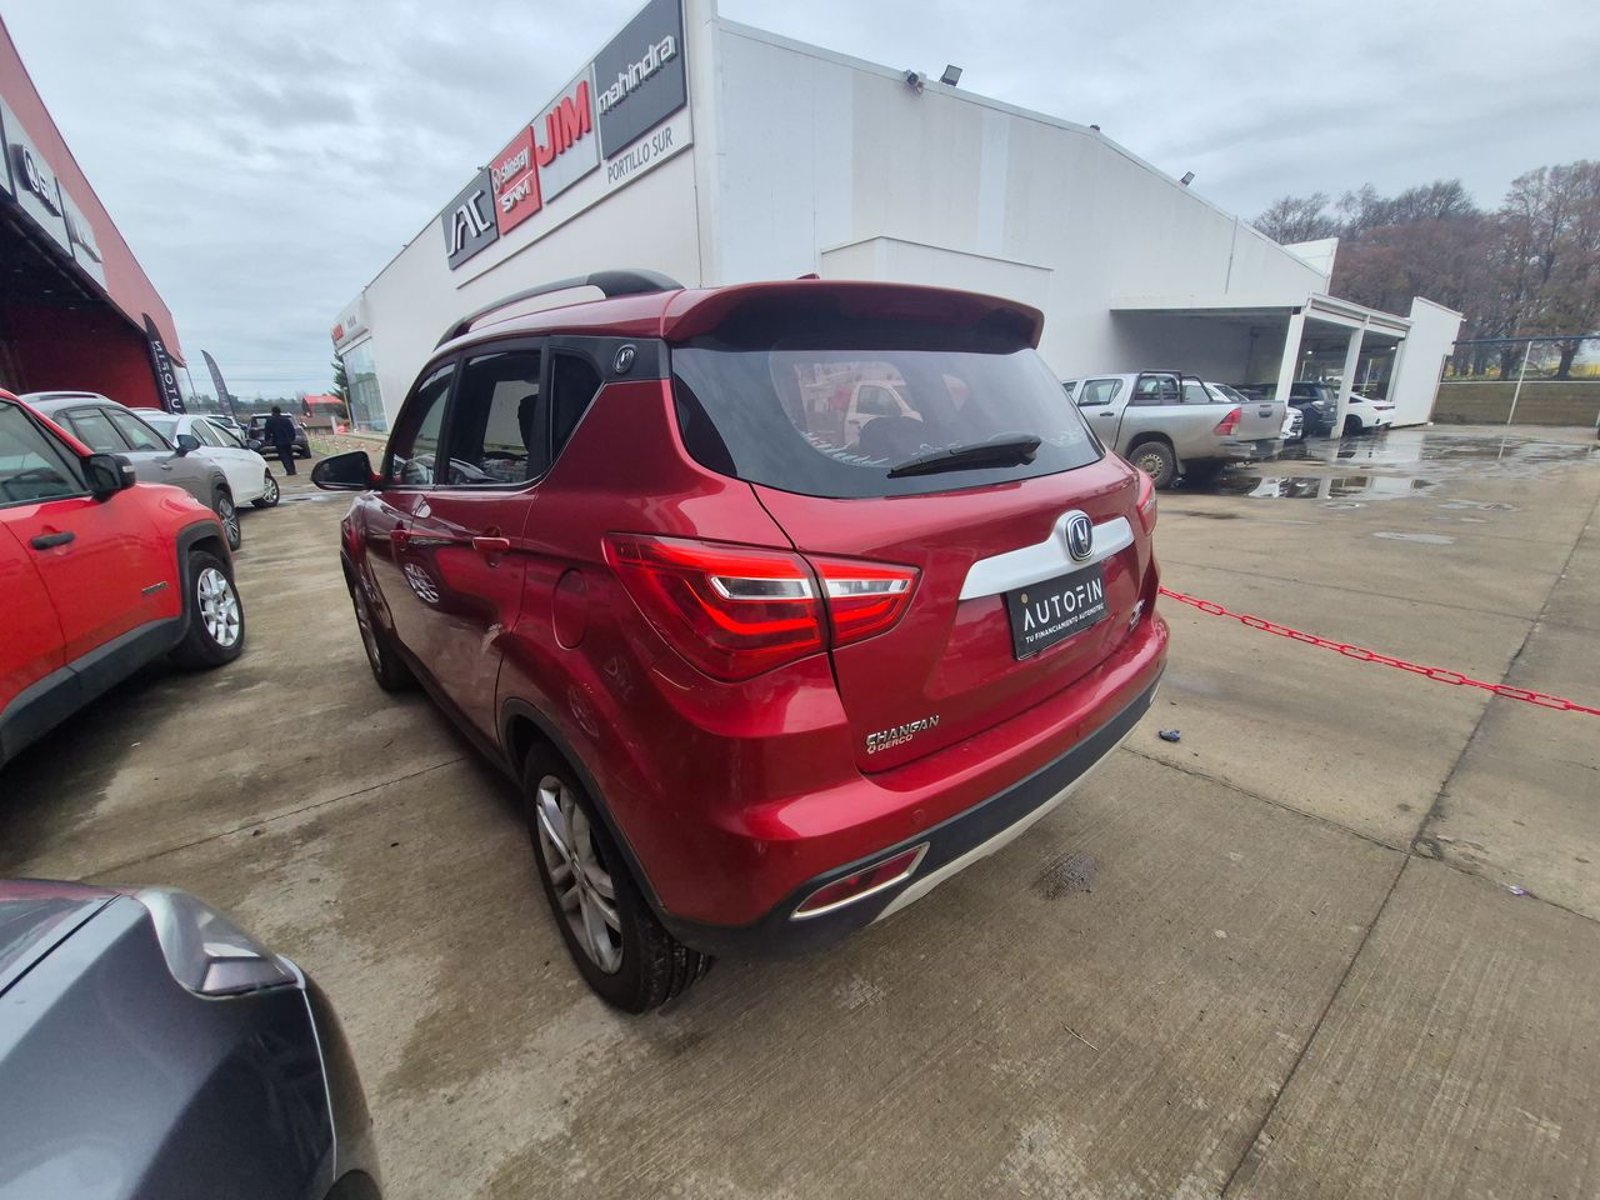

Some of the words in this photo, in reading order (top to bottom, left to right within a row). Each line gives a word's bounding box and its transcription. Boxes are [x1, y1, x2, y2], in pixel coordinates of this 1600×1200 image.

[598, 35, 677, 115] mahindra
[535, 80, 591, 168] JIM
[607, 142, 651, 184] PORTILLO
[652, 125, 674, 157] SUR
[447, 190, 492, 257] JAC
[501, 179, 532, 213] SWM
[1024, 577, 1103, 632] AUTOFIN
[1025, 634, 1036, 644] TU
[866, 714, 940, 746] CHANGAN
[877, 733, 914, 752] DERCO
